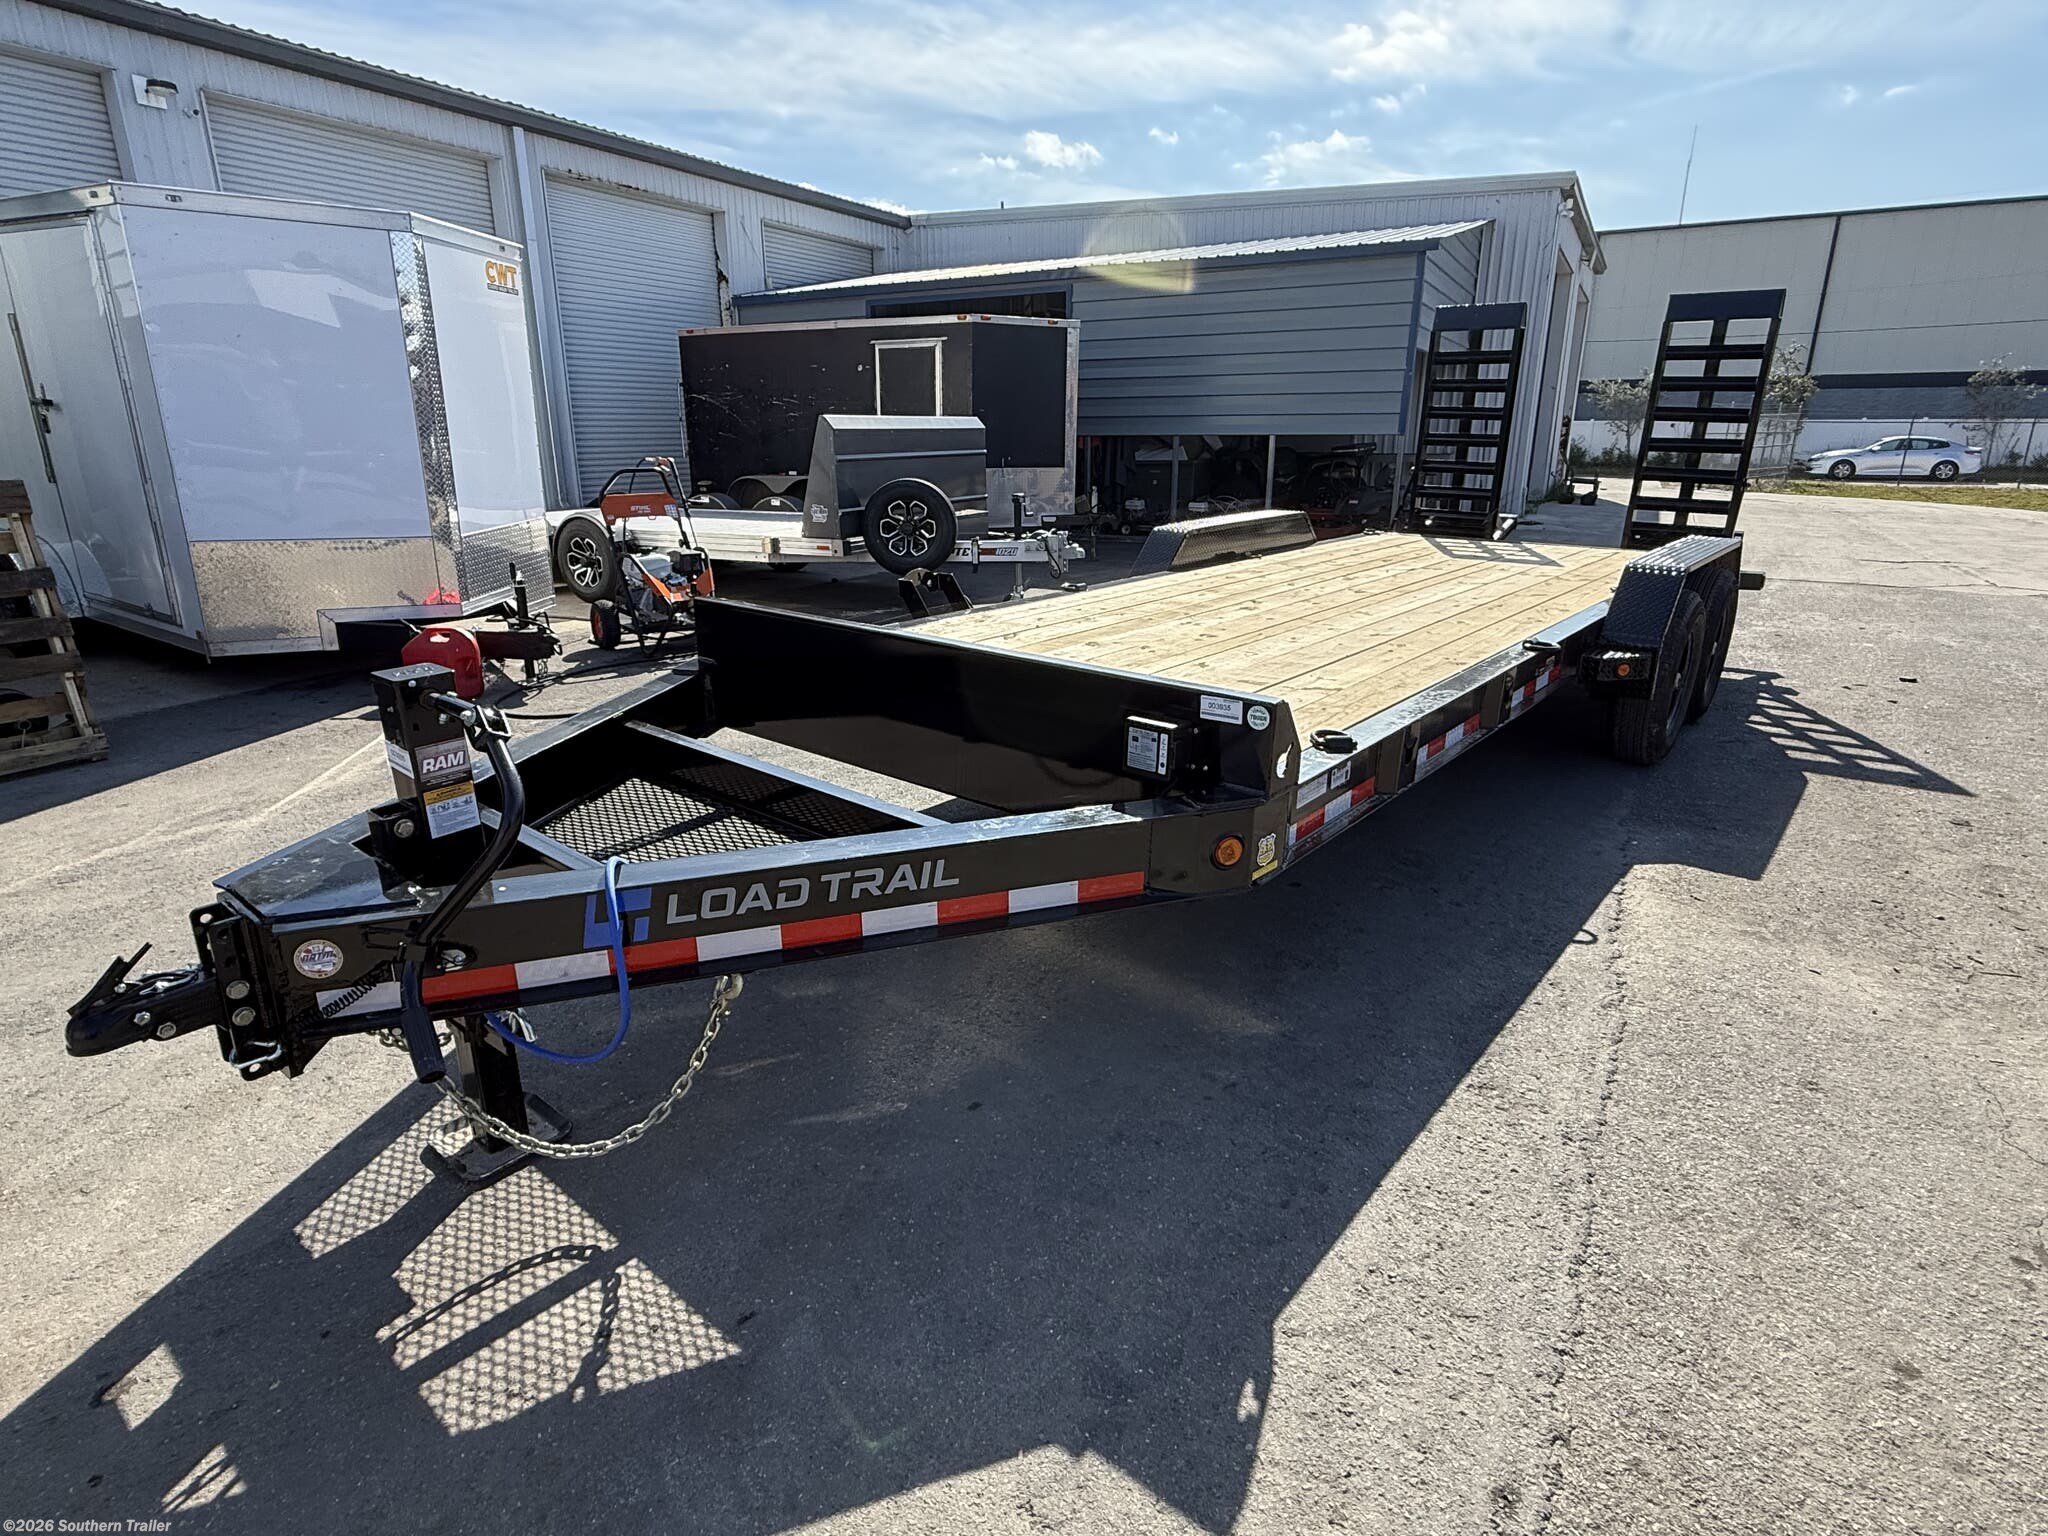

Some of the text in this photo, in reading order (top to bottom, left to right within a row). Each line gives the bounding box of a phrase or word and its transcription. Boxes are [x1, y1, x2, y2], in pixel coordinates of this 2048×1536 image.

[485, 260, 517, 288] CWT
[422, 751, 465, 774] RAM
[666, 877, 810, 926] LOAD
[820, 858, 960, 903] TRAIL
